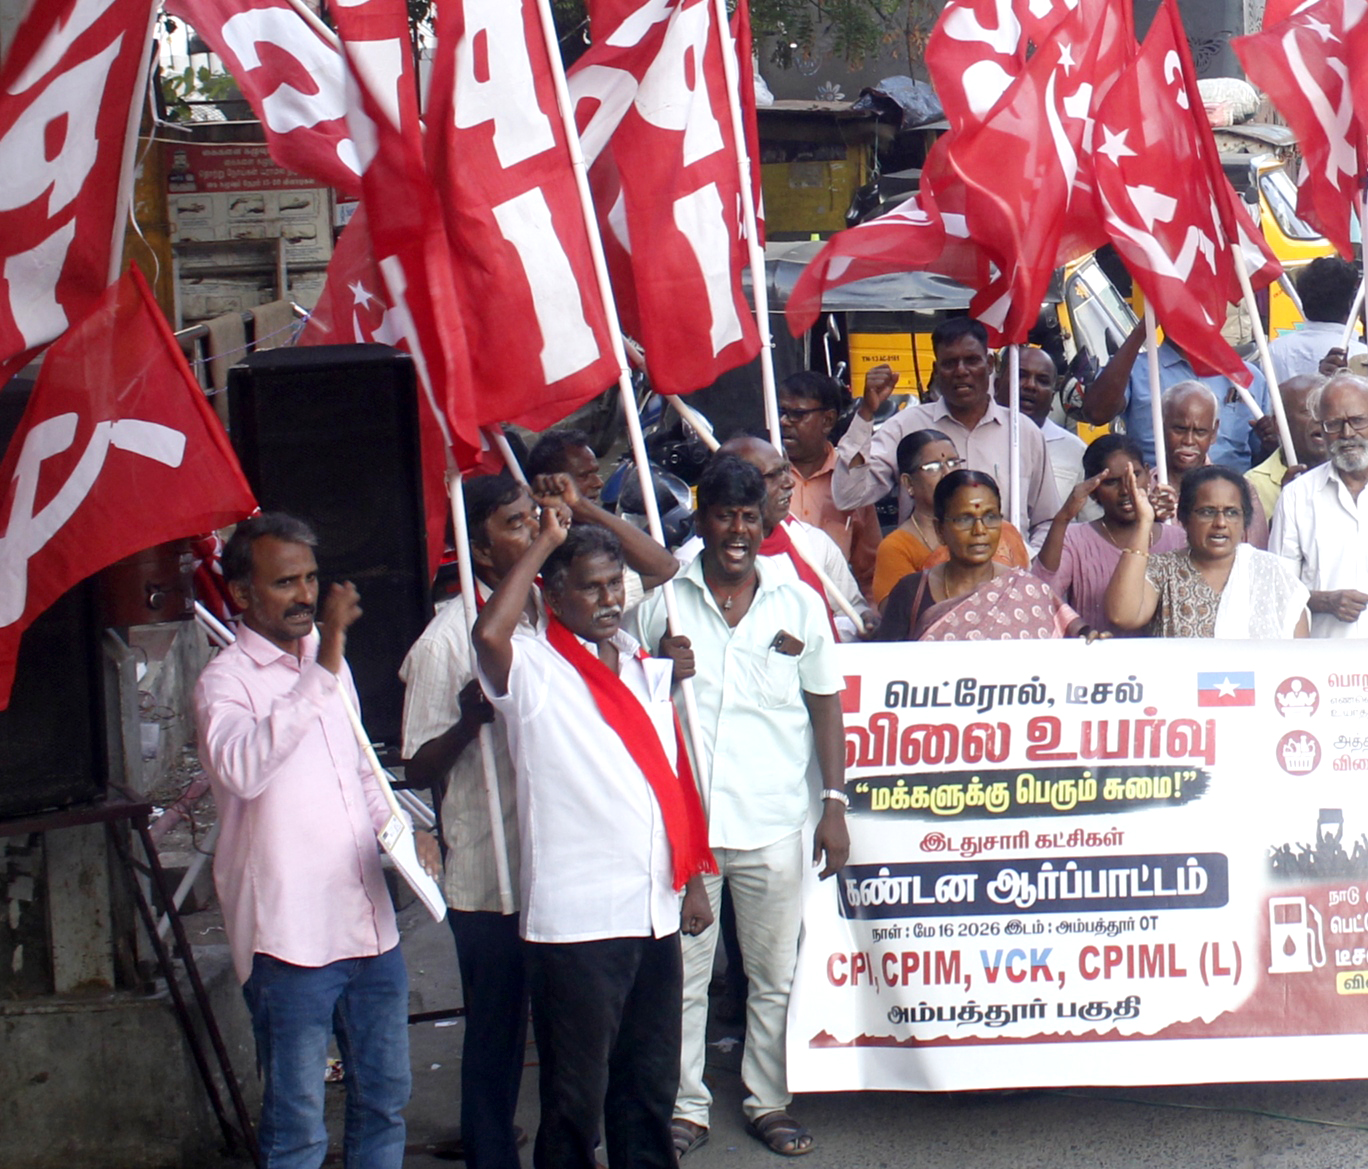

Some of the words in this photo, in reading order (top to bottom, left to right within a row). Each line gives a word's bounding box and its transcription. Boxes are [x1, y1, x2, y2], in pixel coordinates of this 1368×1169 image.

[884, 675, 1055, 714] பெட்ரோல்,
[1065, 675, 1144, 705] டீசல்
[844, 711, 1012, 769] விலை
[1025, 706, 1216, 766] உயர்வு
[1015, 771, 1098, 811] பெரும்
[919, 829, 1030, 858] இடதுசாரி
[1034, 826, 1125, 850] கட்சிகள்
[845, 866, 979, 907] கண்டன
[986, 856, 1208, 909] ஆர்ப்பாட்டம்
[1328, 886, 1360, 906] நாடு
[871, 923, 902, 944] நாள்
[913, 922, 936, 938] மே
[939, 923, 955, 938] 16
[957, 921, 1001, 937] 2026
[1003, 918, 1045, 936] இடம்
[1055, 917, 1136, 937] அம்பத்தூர்
[1139, 915, 1159, 931] OT
[881, 949, 972, 993] CPIM,
[979, 947, 1066, 990] VCK,
[1078, 942, 1187, 981] CPIML
[1199, 940, 1243, 987] (L)
[887, 998, 1048, 1028] அம்பத்தூர்
[1056, 994, 1142, 1024] பகுதி
